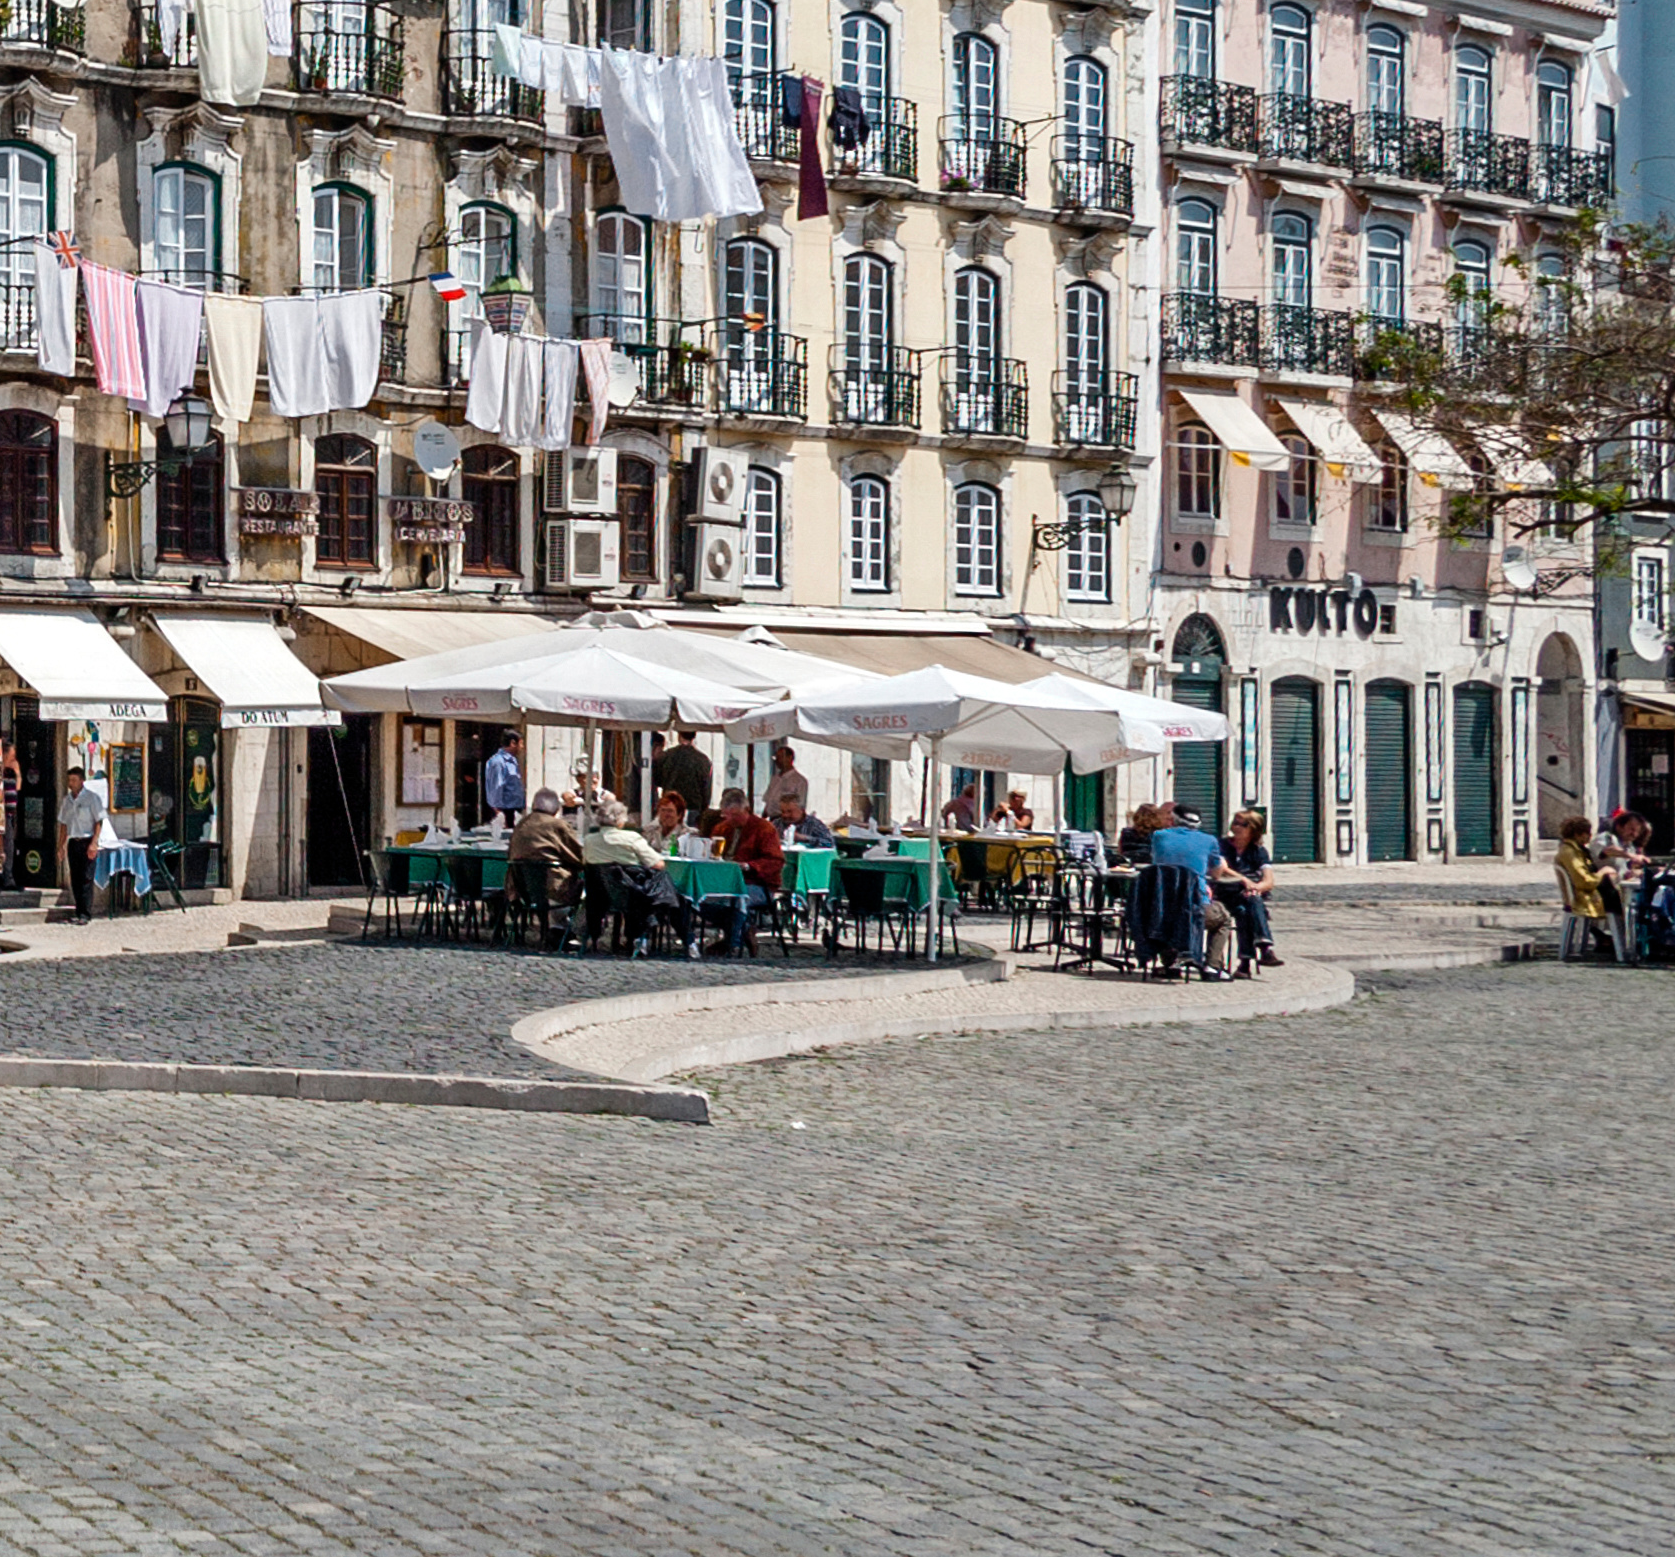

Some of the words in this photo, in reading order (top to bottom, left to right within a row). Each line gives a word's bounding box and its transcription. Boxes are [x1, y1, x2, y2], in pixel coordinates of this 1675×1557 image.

[1270, 587, 1378, 639] KULTO
[109, 703, 147, 717] ADEGA
[562, 696, 616, 715] SAGRES
[241, 710, 257, 724] DO
[853, 715, 908, 730] SAGRES
